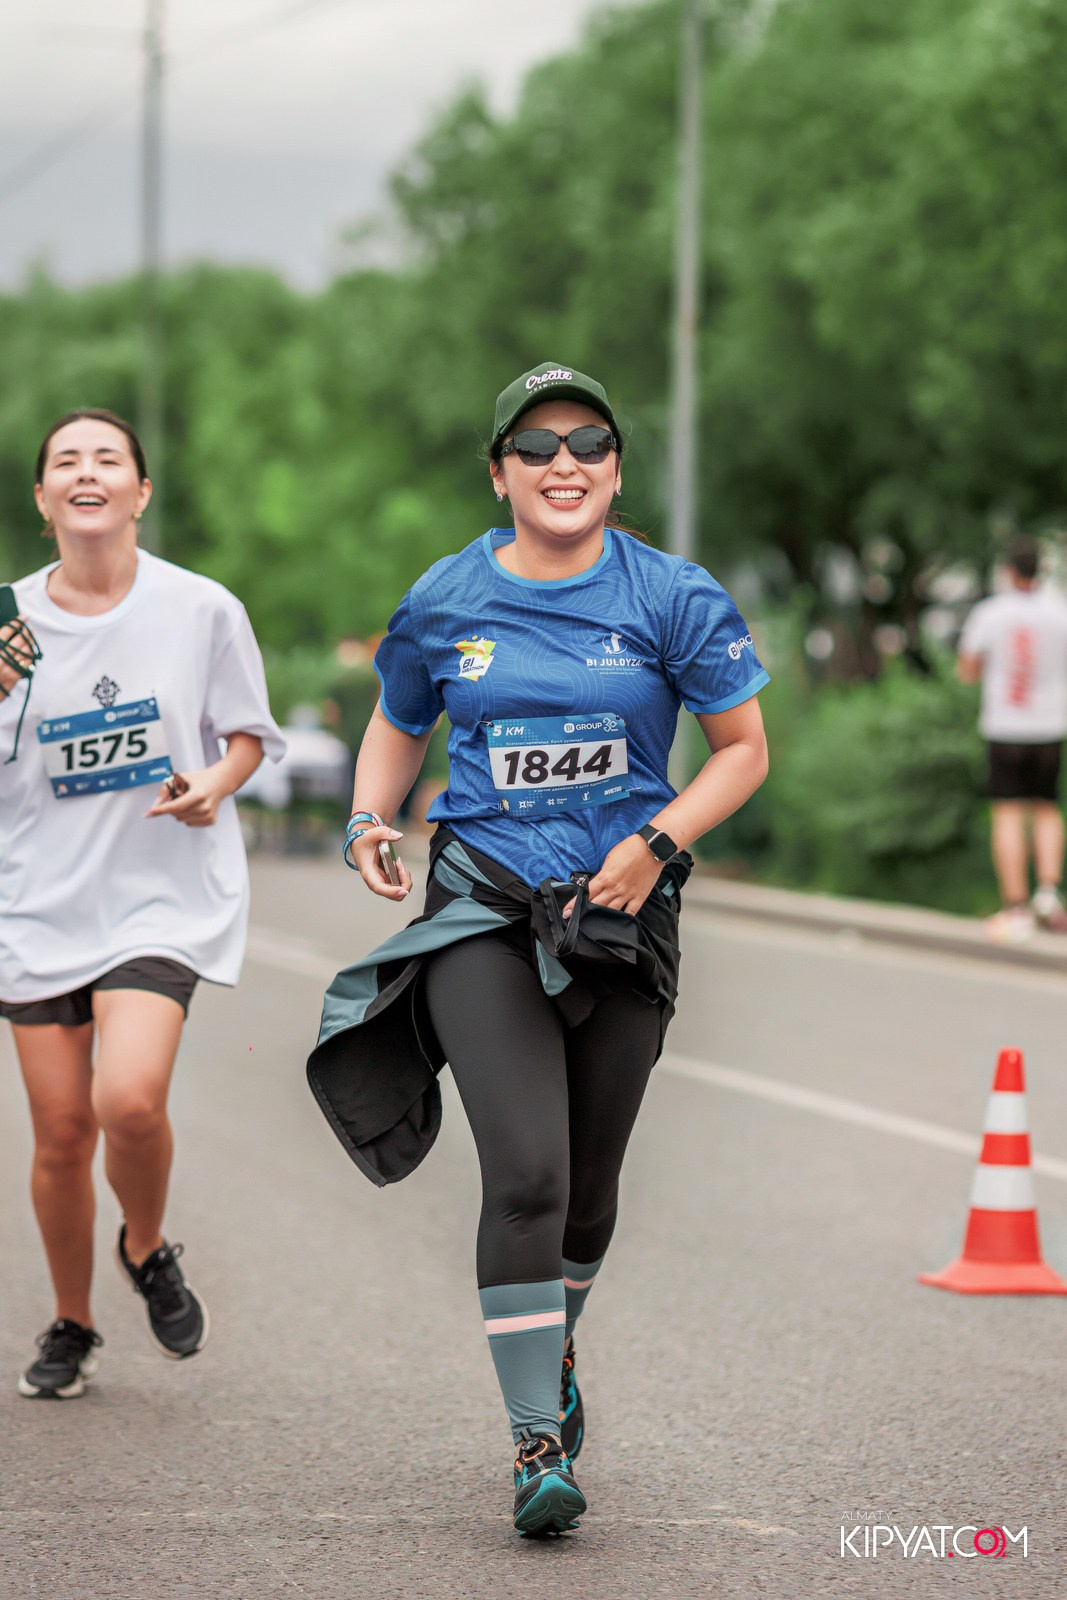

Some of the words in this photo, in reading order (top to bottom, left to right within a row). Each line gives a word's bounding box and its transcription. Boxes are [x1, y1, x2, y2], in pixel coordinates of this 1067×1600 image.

[525, 368, 573, 389] Create
[463, 657, 475, 669] BI
[586, 658, 597, 666] BI
[492, 725, 503, 737] 5
[505, 726, 525, 736] KM
[575, 722, 603, 731] GROUP
[60, 727, 149, 771] 1575
[504, 744, 613, 785] 1844
